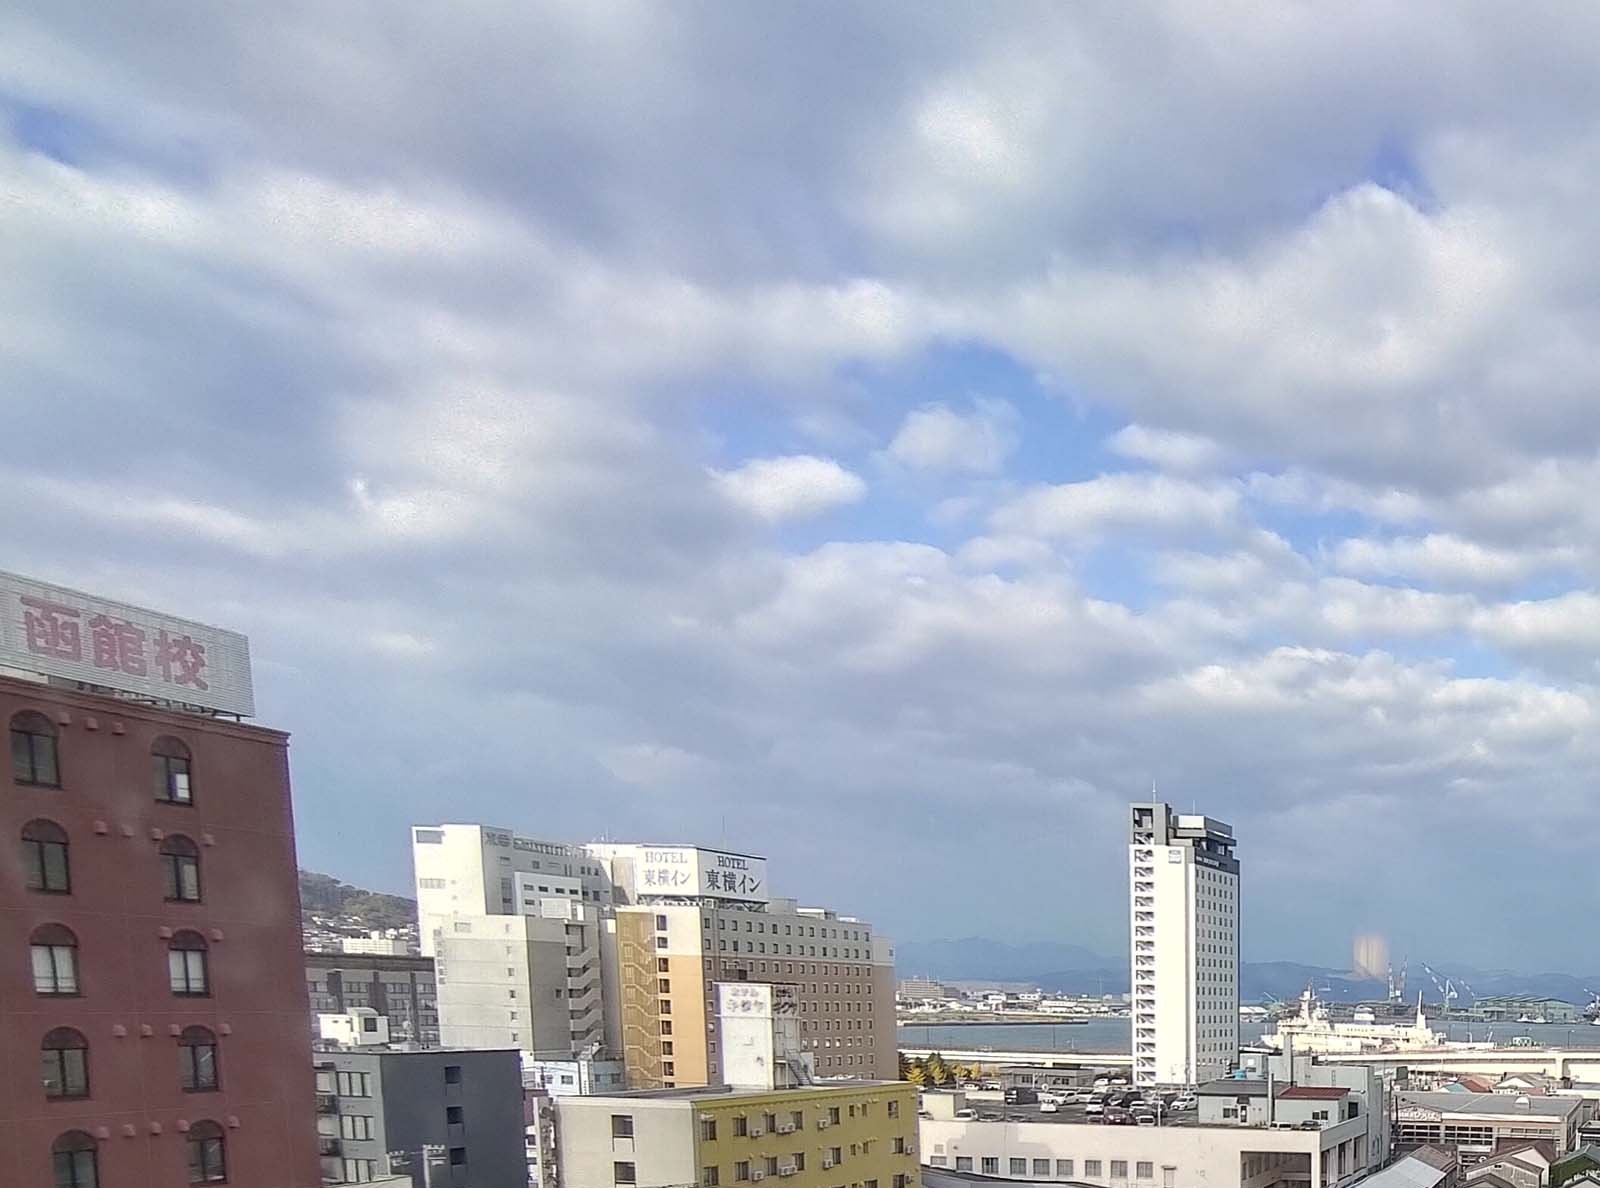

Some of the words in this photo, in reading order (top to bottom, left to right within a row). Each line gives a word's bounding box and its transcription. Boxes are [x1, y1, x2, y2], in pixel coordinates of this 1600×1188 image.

[20, 596, 209, 691] 函館校
[645, 851, 688, 864] HOTEL
[717, 855, 749, 871] HOTEL
[643, 869, 691, 887] 東横イン
[705, 869, 761, 894] 東横イン
